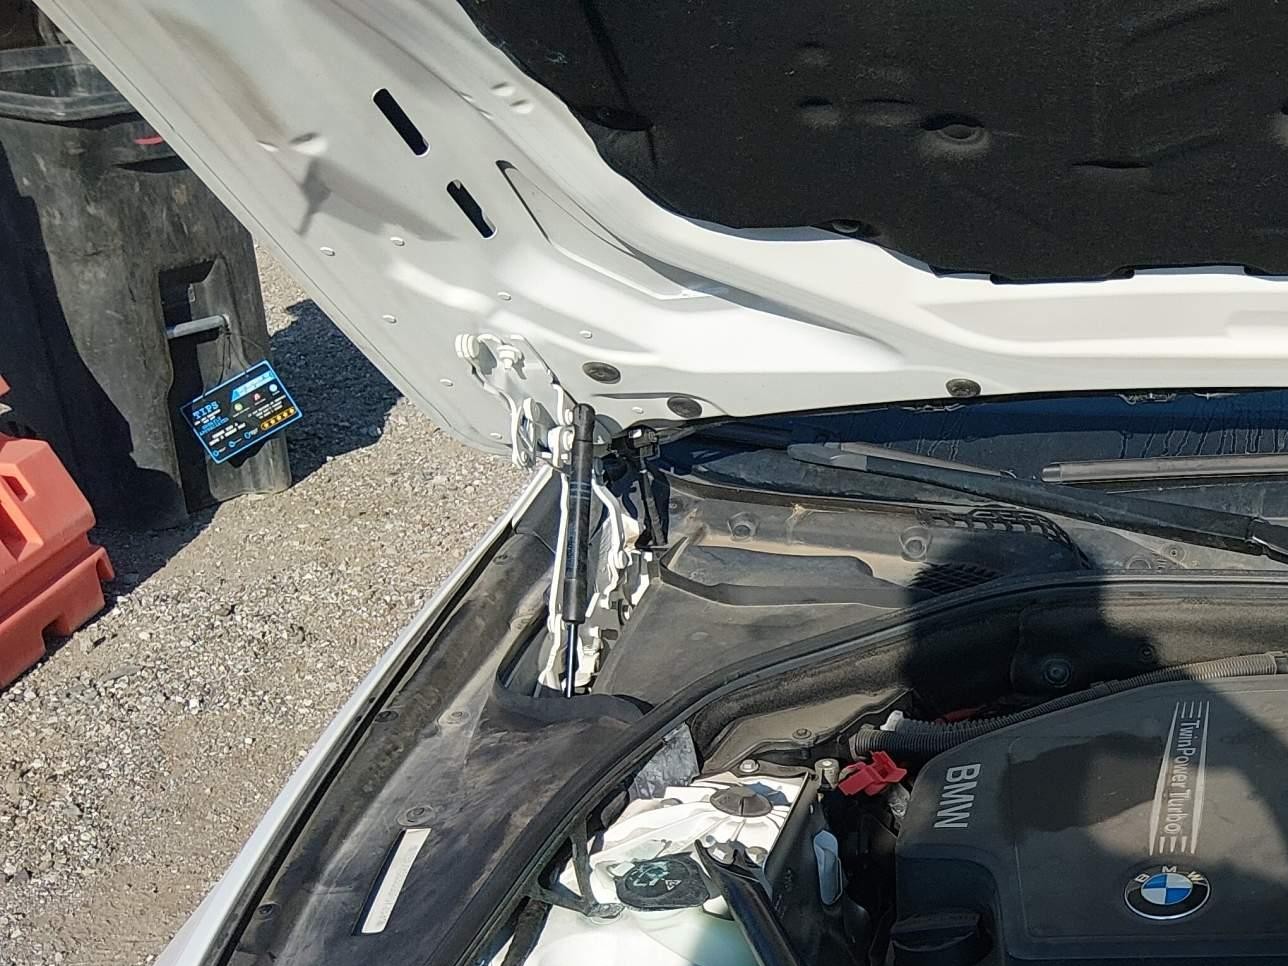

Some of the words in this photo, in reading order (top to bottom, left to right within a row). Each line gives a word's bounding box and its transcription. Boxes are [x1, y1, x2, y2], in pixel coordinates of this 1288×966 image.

[192, 401, 219, 421] TIPS
[1170, 719, 1201, 788] TwinPower
[934, 763, 981, 829] BMW
[1164, 787, 1193, 835] Turbo
[1134, 865, 1205, 884] BMW
